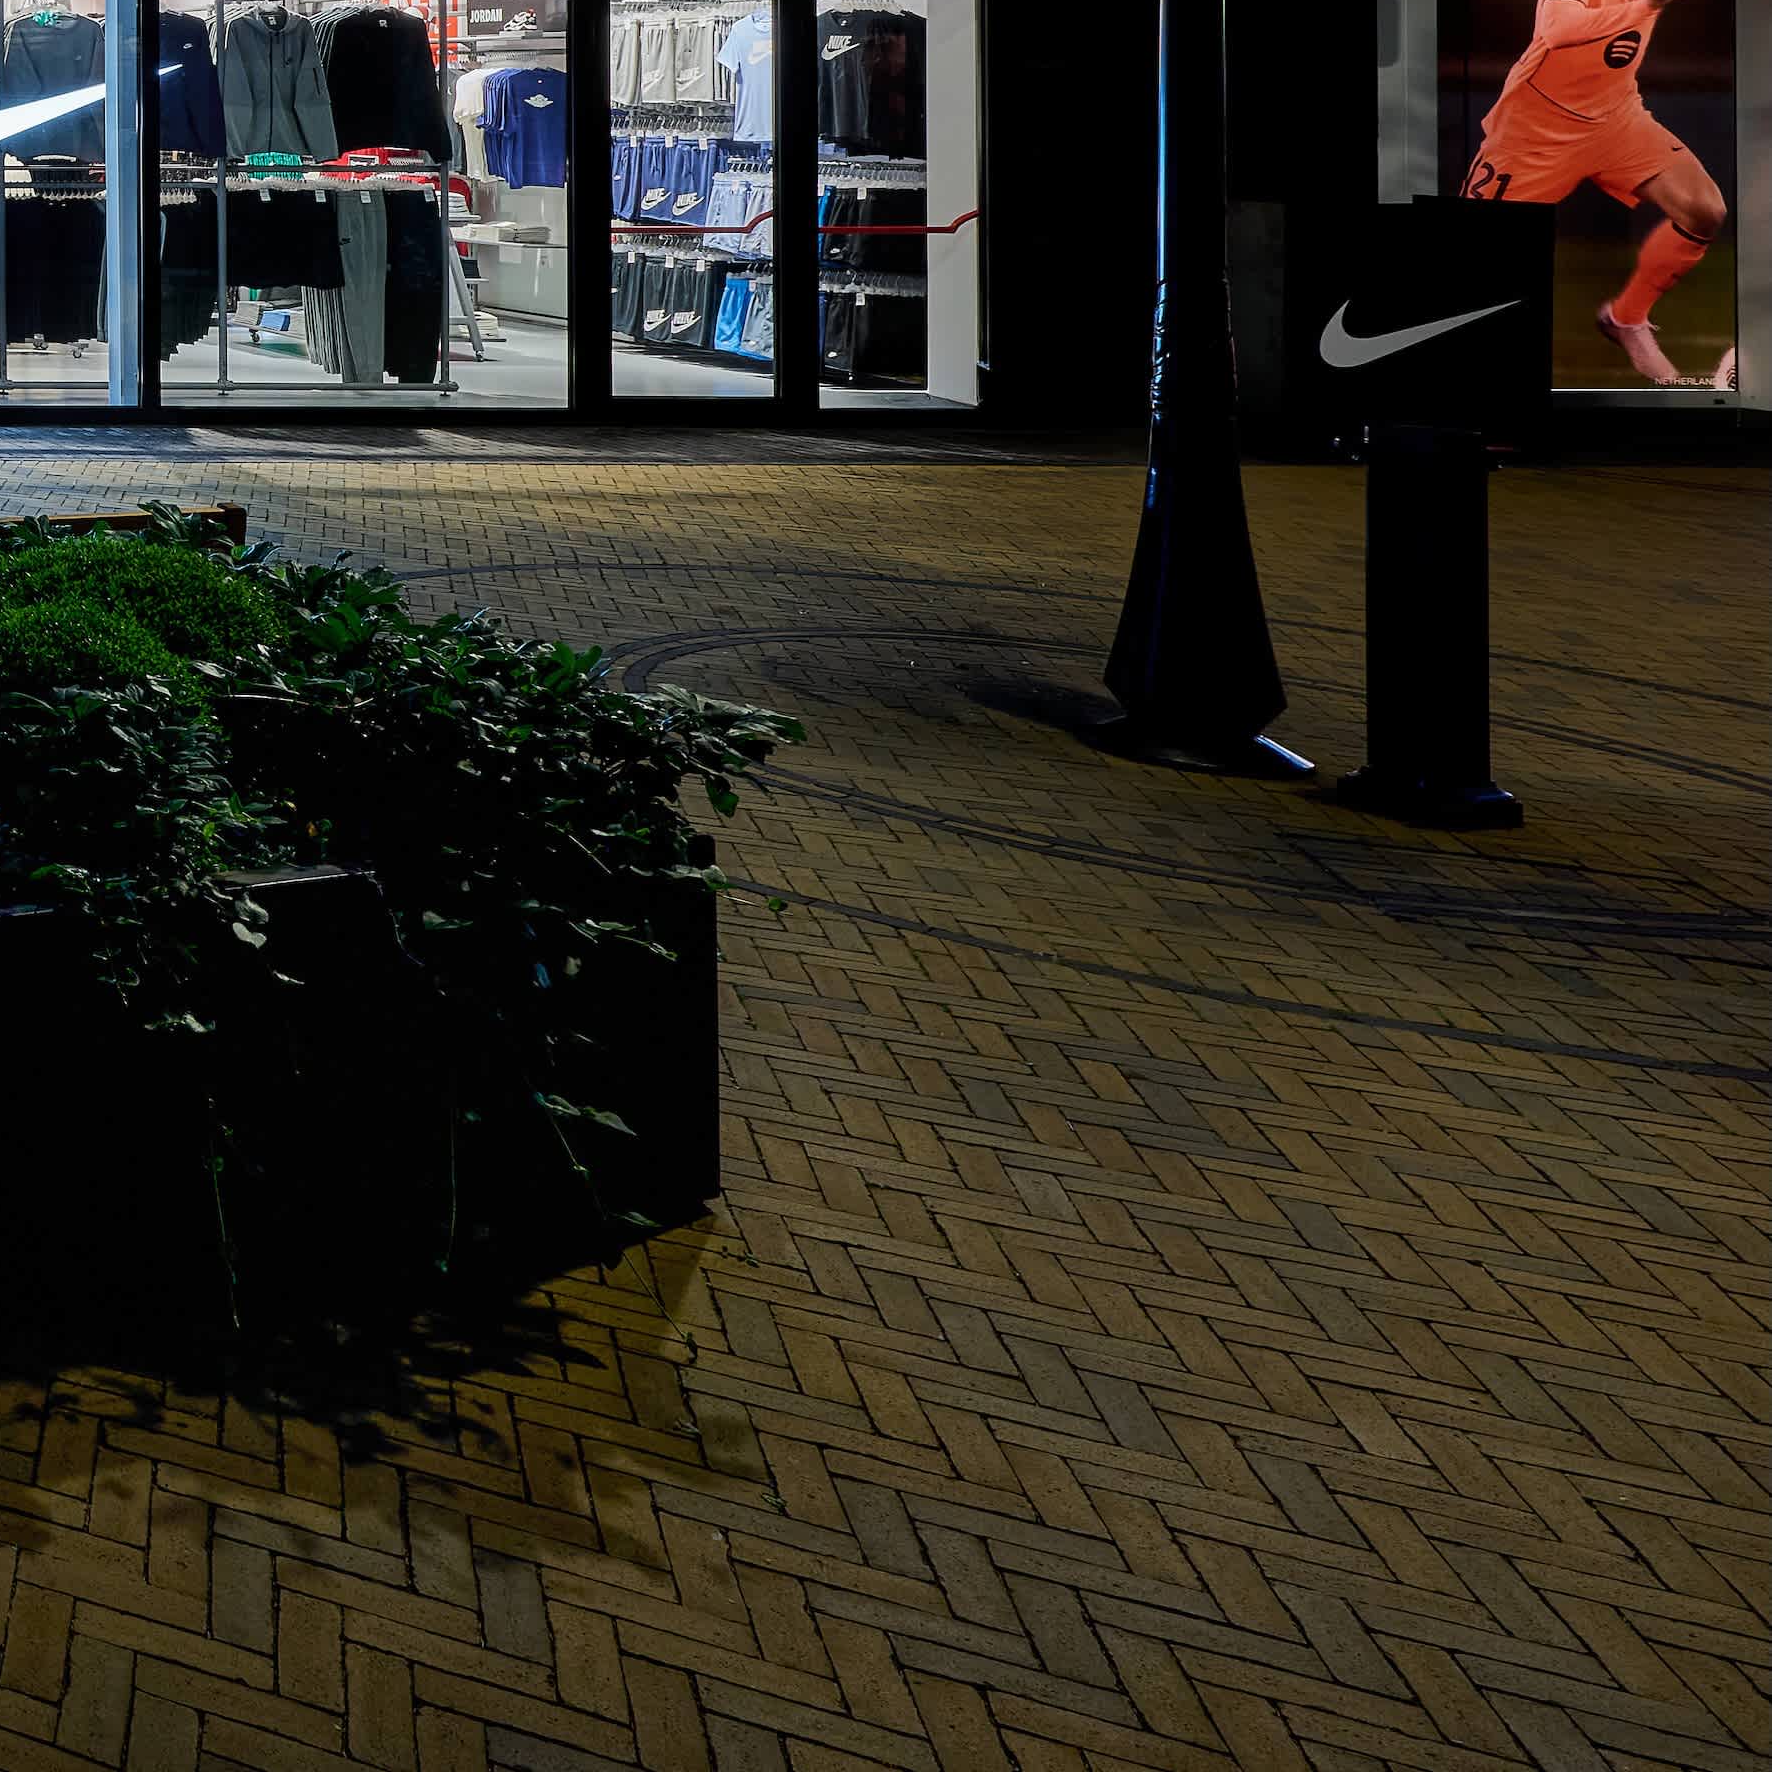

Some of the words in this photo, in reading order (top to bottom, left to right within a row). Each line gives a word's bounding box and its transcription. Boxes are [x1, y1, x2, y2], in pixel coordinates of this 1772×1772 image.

[469, 7, 503, 23] JORDAN
[827, 35, 853, 50] NIKE
[1470, 162, 1513, 201] 21
[646, 188, 665, 201] NIKE
[676, 192, 698, 207] NIKE
[646, 309, 665, 322] NIKE
[673, 311, 696, 324] NIKE
[1654, 377, 1723, 386] NETHERLAN
